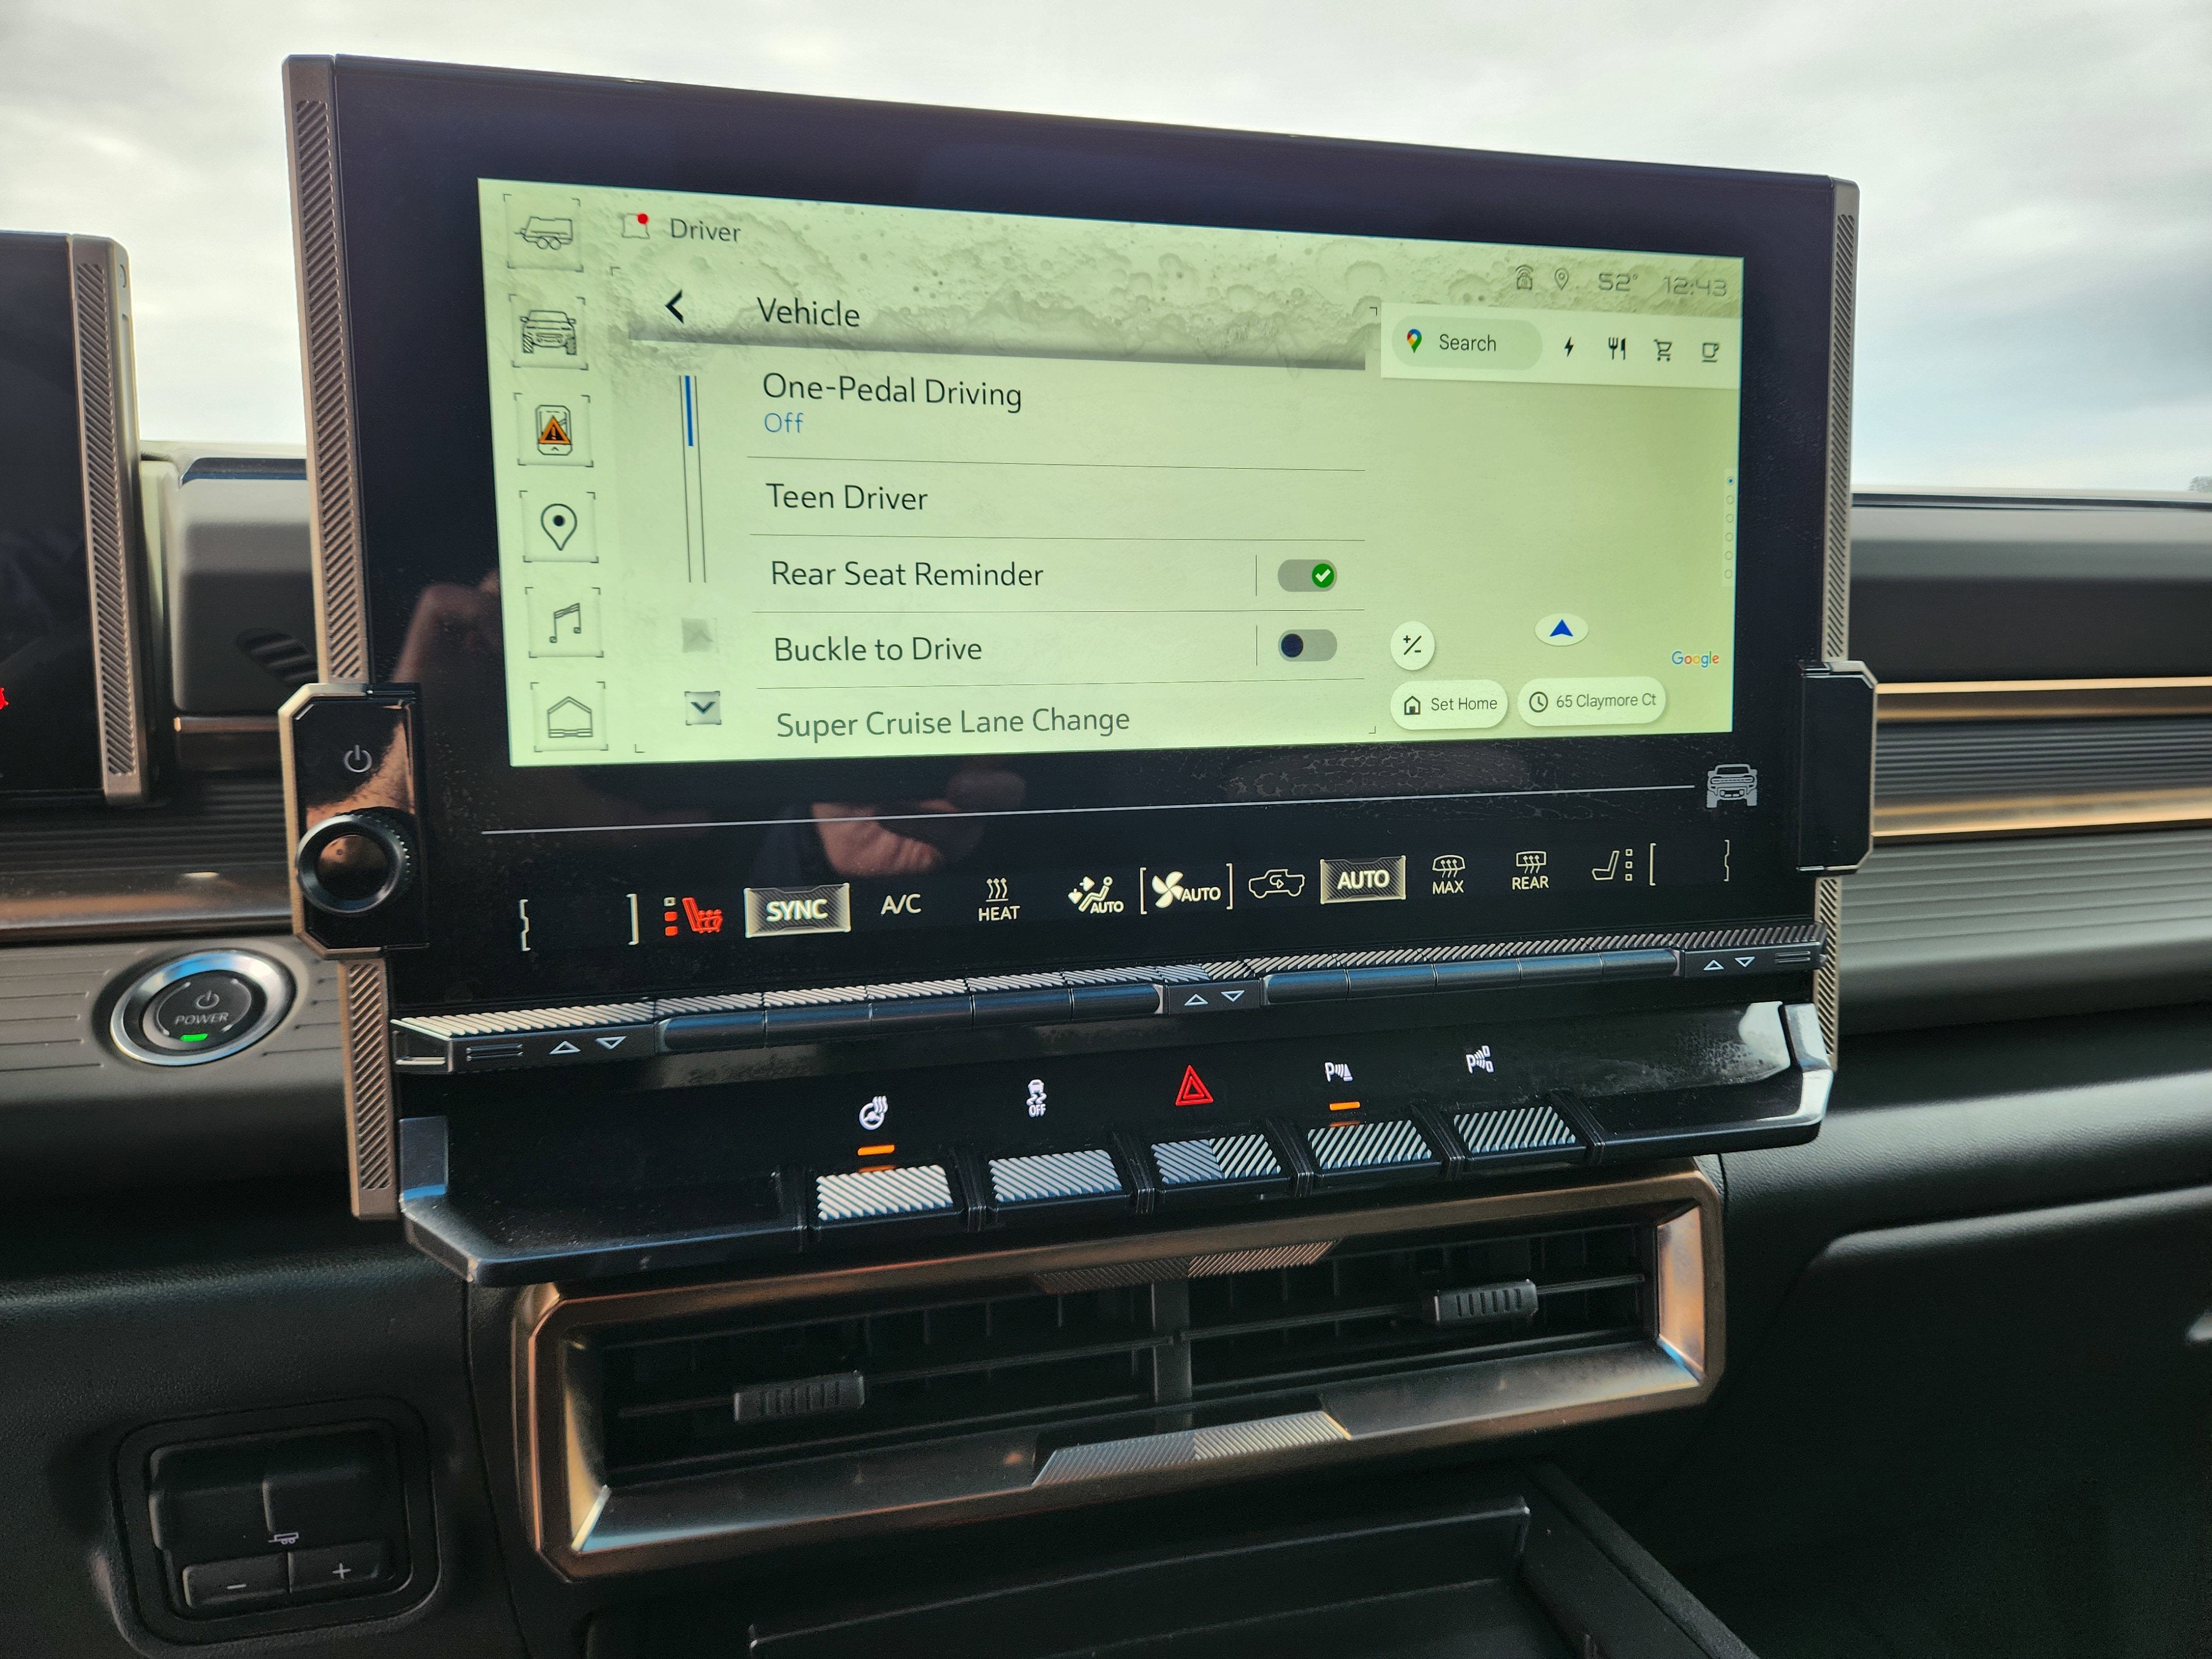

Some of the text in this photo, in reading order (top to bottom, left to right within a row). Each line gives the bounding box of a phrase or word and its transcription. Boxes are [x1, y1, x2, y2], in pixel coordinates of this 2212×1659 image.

[670, 218, 741, 242] Driver
[1664, 275, 1726, 296] 12:43
[758, 297, 860, 327] Vehicle
[1439, 333, 1496, 352] Search
[763, 372, 1021, 413] One-Pedal Driving
[764, 412, 804, 433] Off
[766, 483, 928, 510] Teen Driver
[771, 561, 1044, 586] Rear Seat Reminder
[775, 636, 982, 661] Buckle to Drive
[1671, 650, 1719, 667] Google
[1431, 696, 1498, 711] Set Home
[1556, 692, 1656, 711] 65 Claymore Ct
[777, 707, 1130, 743] Super Cruise Lane Change
[1337, 869, 1390, 889] AUTO
[1432, 881, 1464, 894] MAX
[1511, 875, 1549, 890] REAR
[880, 894, 922, 915] A/C
[1181, 887, 1221, 902] AUTO
[766, 899, 828, 922] SYNC
[978, 905, 1020, 922] HEAT
[1090, 900, 1124, 914] AUTO
[175, 1011, 229, 1025] POWER
[1029, 1104, 1046, 1117] OFF
